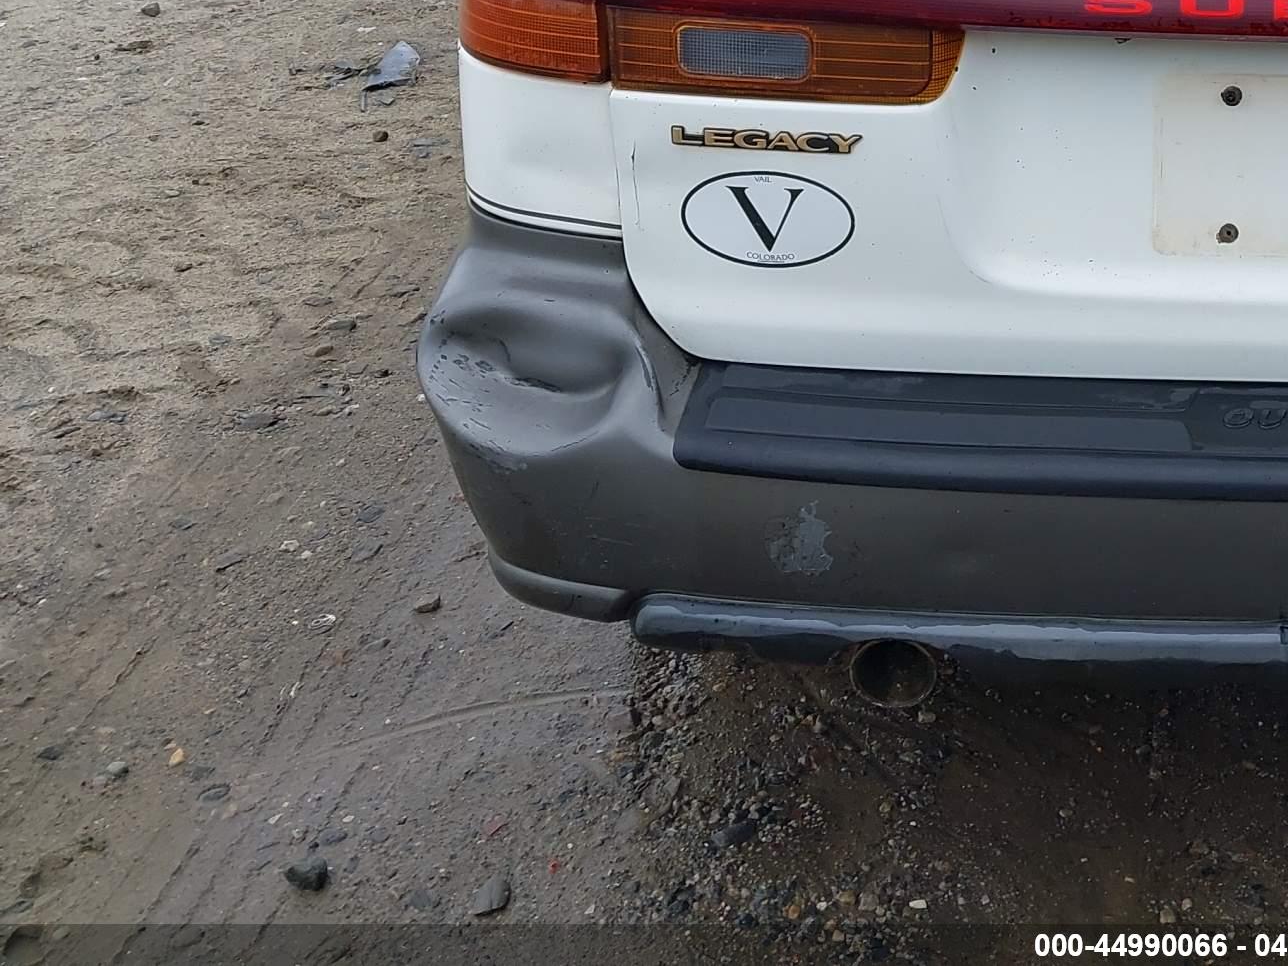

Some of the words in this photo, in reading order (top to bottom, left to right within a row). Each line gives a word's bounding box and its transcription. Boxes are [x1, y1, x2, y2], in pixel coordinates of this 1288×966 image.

[671, 125, 864, 154] LEGACY
[754, 176, 773, 184] VAIL
[725, 185, 805, 253] V
[746, 251, 796, 262] COLORADO
